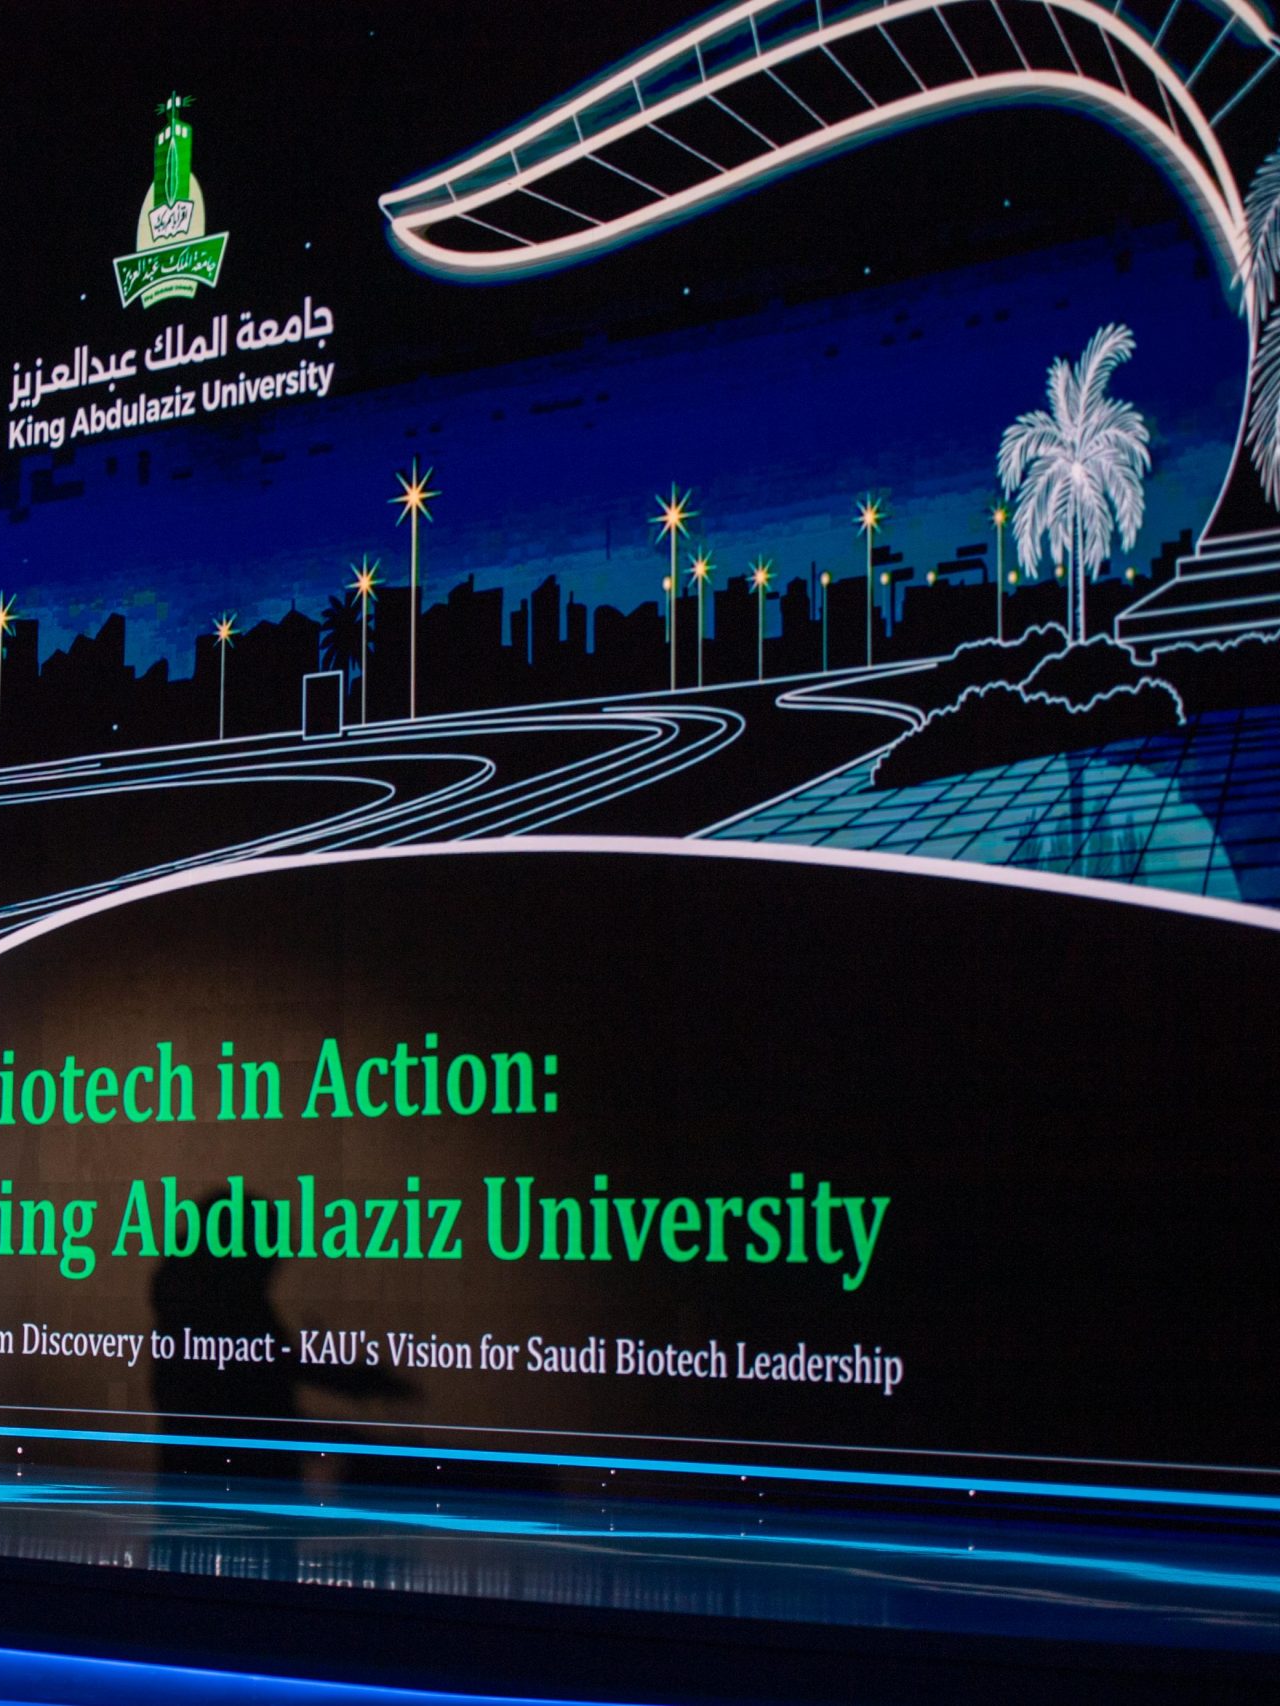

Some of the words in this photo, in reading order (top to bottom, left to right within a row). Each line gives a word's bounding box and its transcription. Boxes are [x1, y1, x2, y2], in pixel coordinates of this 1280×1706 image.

[144, 314, 228, 372] الملك
[236, 296, 334, 349] جامعة
[8, 414, 66, 450] King
[70, 385, 196, 439] Abdulaziz
[202, 359, 335, 412] University
[217, 1041, 283, 1121] in
[300, 1033, 558, 1119] Action:
[112, 1174, 462, 1260] Abdulaziz
[484, 1172, 890, 1291] University
[21, 1322, 143, 1368] Discovery
[150, 1330, 175, 1359] to
[183, 1327, 275, 1370] Impact
[300, 1330, 379, 1366] KAU's
[386, 1332, 472, 1369] Vision
[480, 1333, 520, 1371] for
[527, 1336, 606, 1374] Saudi
[616, 1338, 727, 1378] Biotech
[737, 1342, 903, 1396] Leadership
